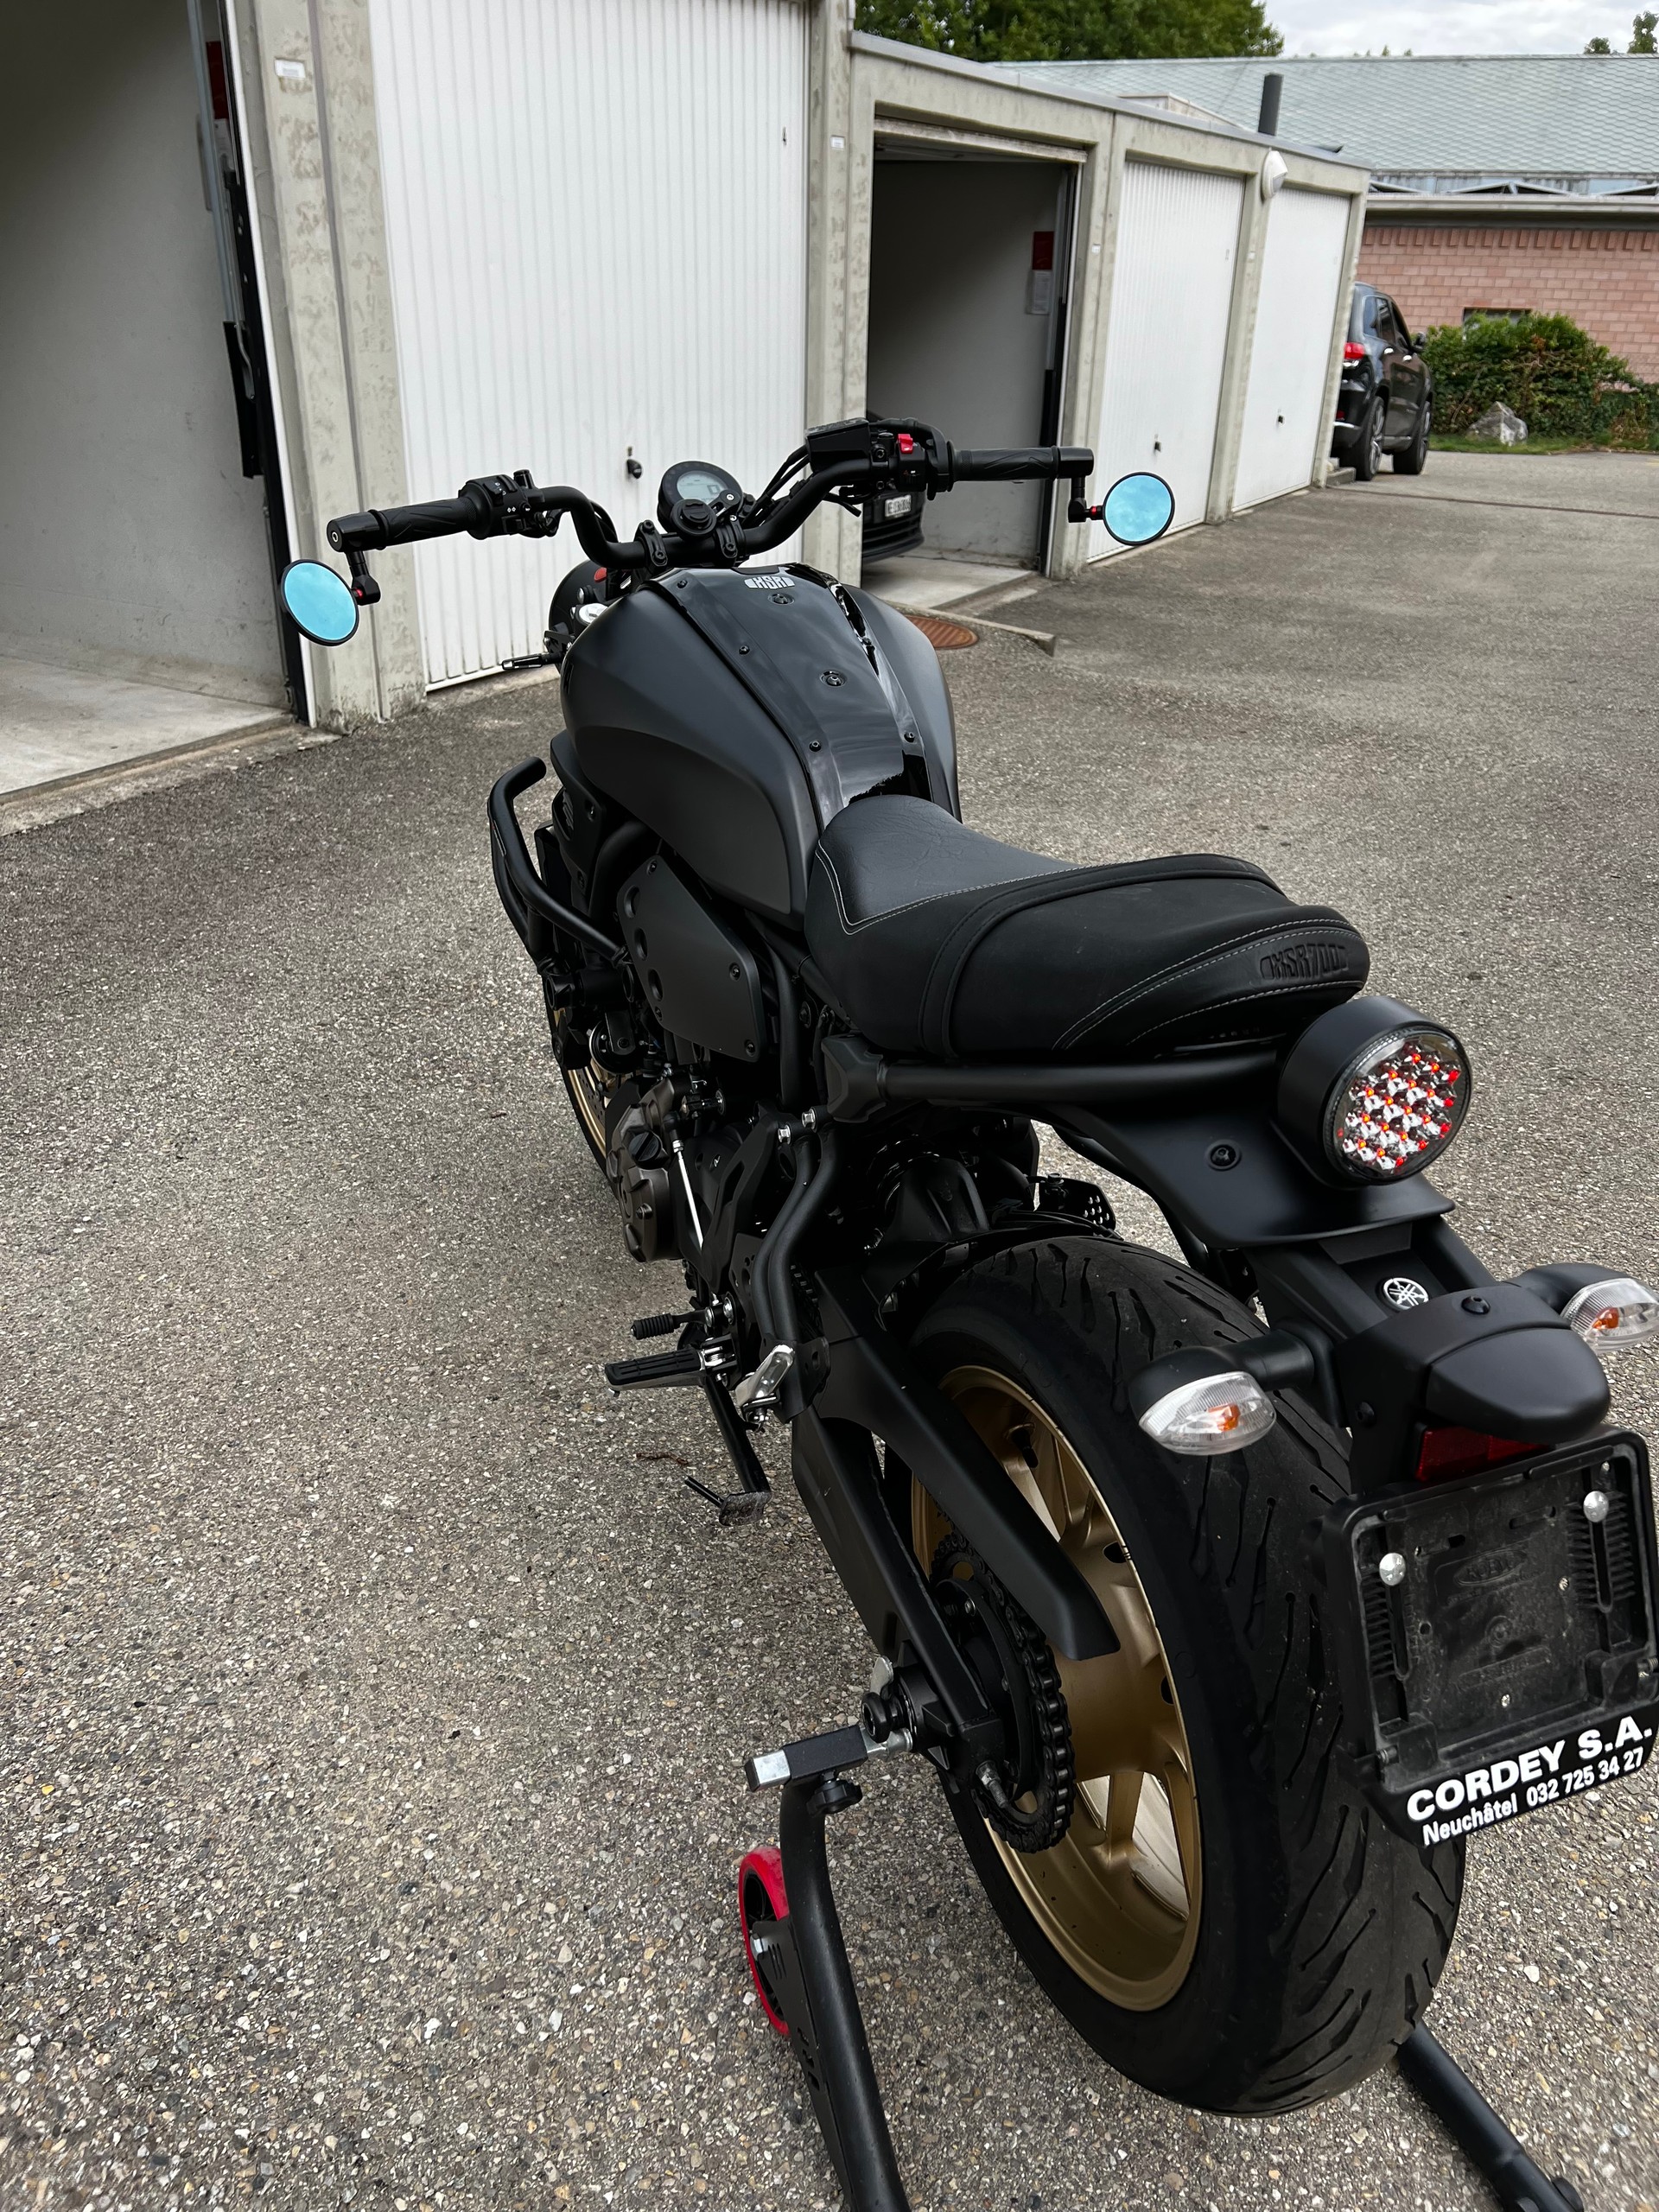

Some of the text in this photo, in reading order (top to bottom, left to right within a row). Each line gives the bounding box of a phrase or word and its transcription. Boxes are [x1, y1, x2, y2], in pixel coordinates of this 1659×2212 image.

[751, 575, 789, 589] XSR
[1272, 943, 1338, 979] XSR700
[1407, 1715, 1654, 1822] CORDEY S.A.
[1422, 1747, 1644, 1847] Neuchâtel 032 725 34 27
